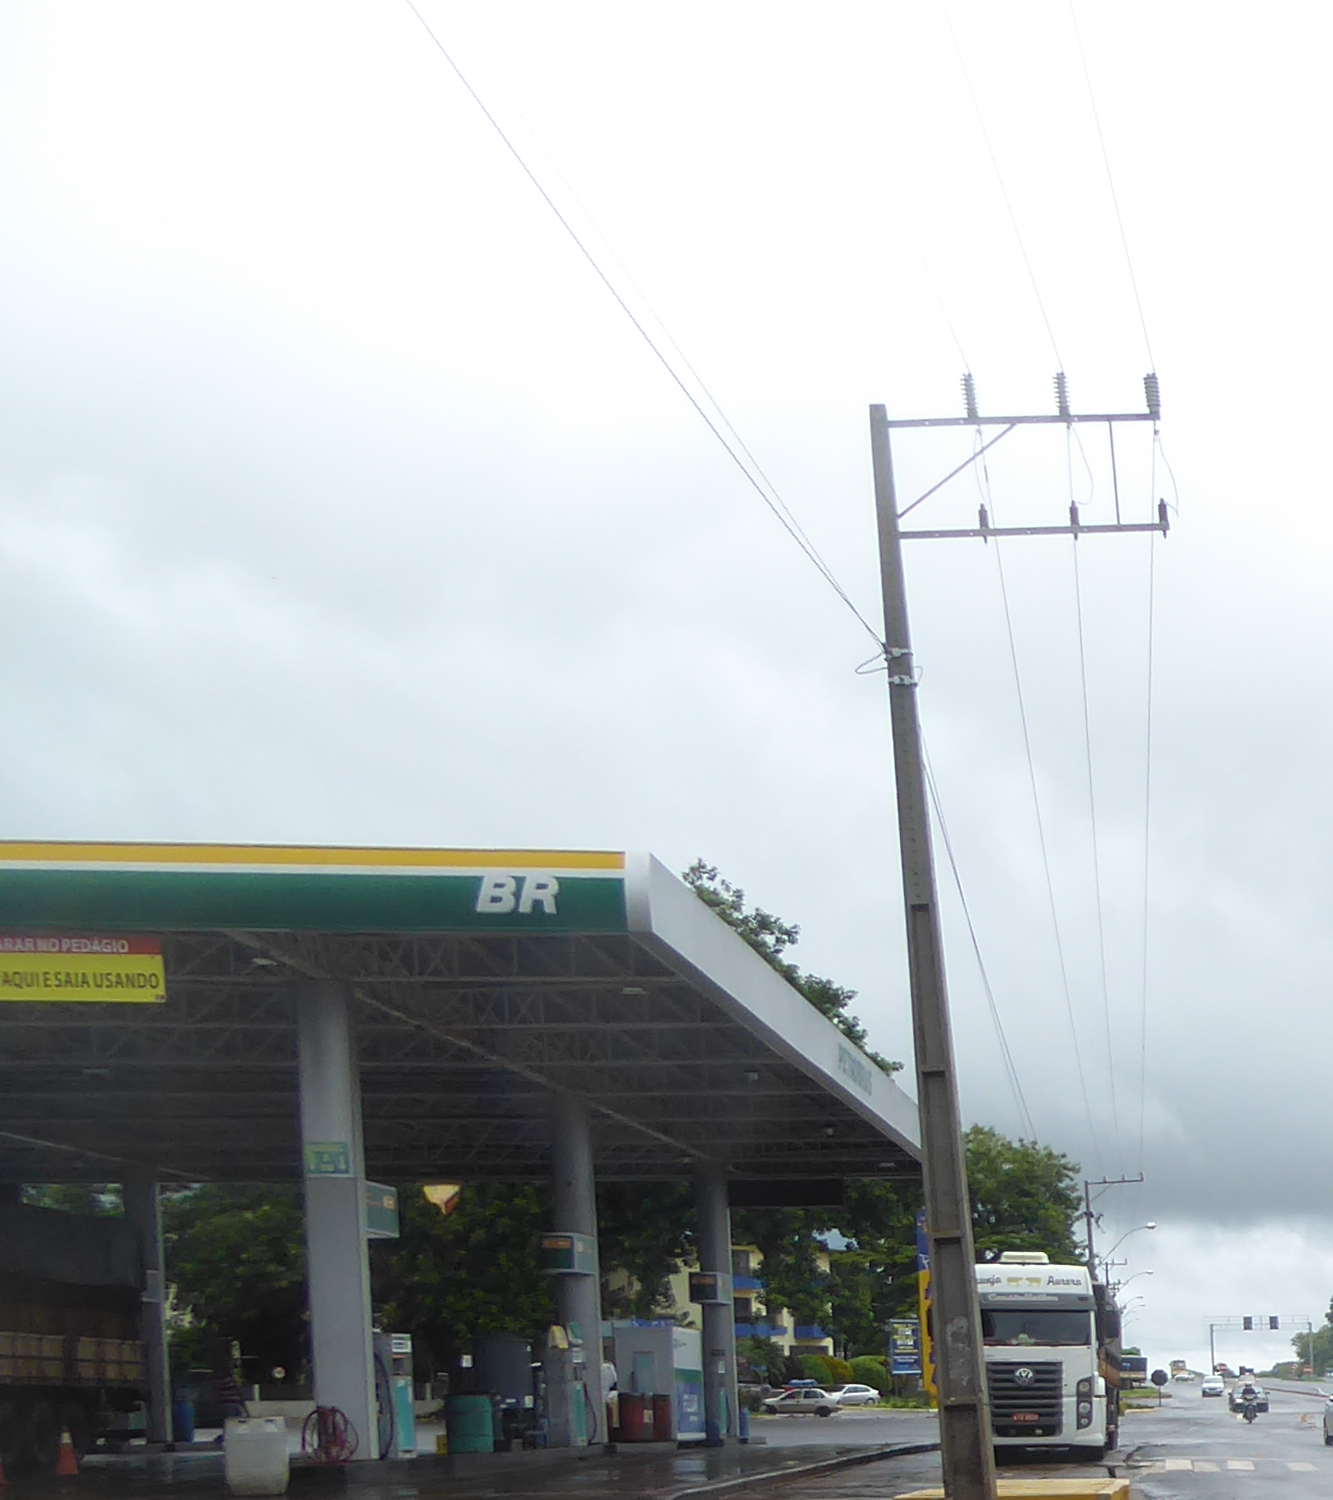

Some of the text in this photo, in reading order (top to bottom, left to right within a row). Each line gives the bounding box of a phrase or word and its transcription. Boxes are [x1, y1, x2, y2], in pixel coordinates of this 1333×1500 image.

[476, 873, 559, 914] BR
[37, 938, 59, 952] NO
[62, 937, 129, 953] PEDÁGIO
[2, 971, 160, 990] AQUI E SAIA USANDO
